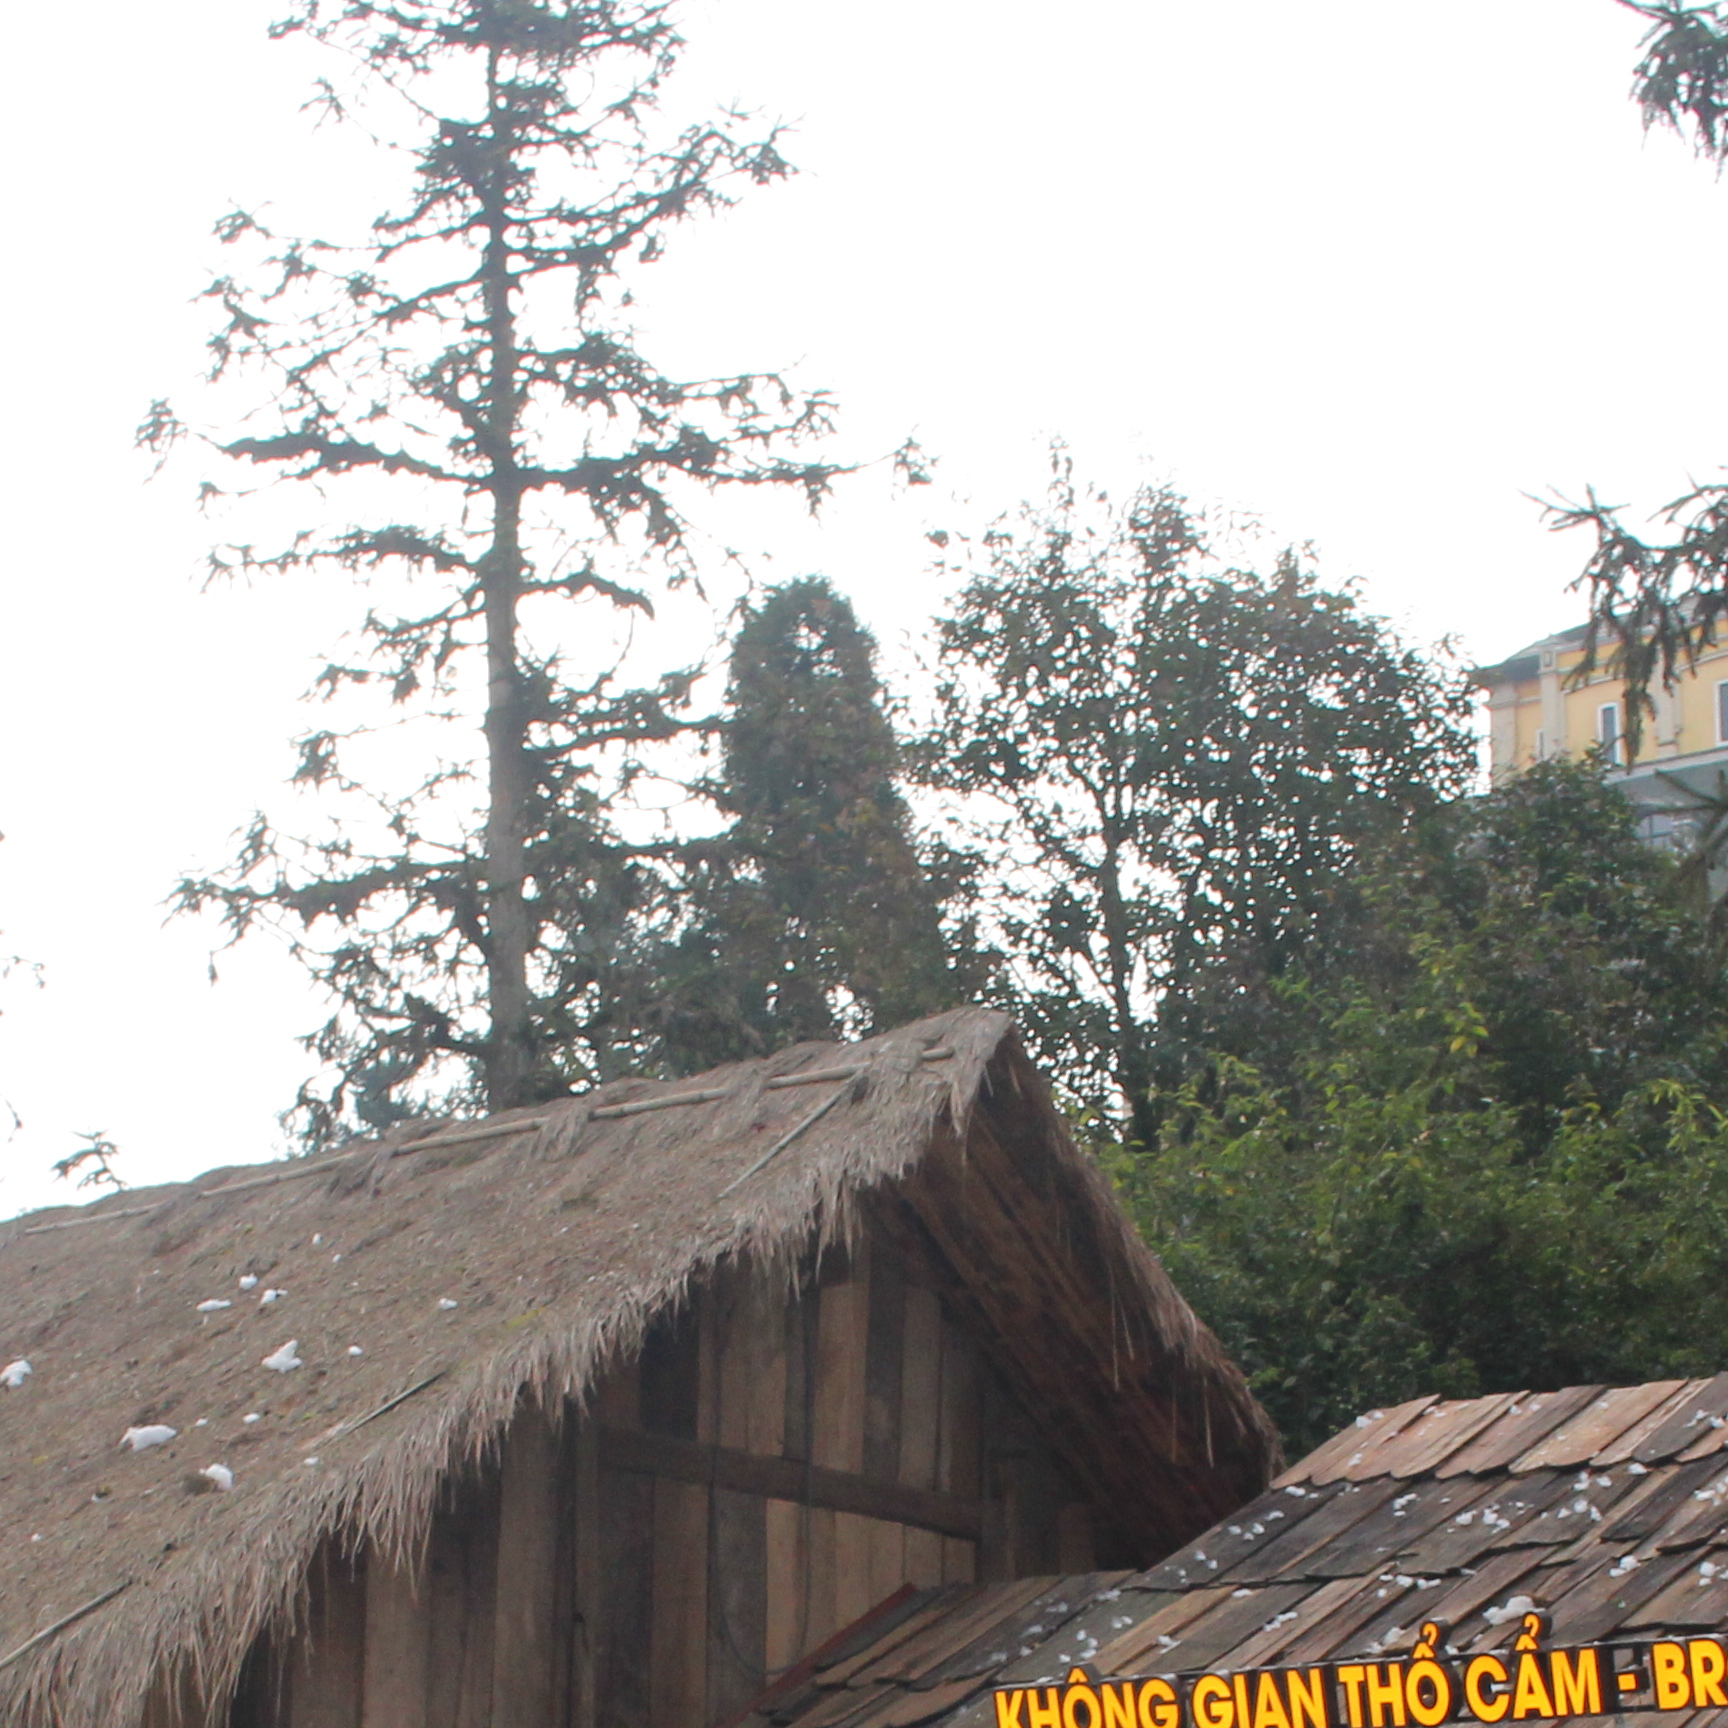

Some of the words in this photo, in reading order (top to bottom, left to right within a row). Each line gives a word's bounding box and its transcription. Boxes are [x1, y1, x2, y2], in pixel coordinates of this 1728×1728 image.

[1339, 1622, 1450, 1728] THỔ
[1466, 1612, 1602, 1722] CẨM
[1617, 1671, 1637, 1691] -
